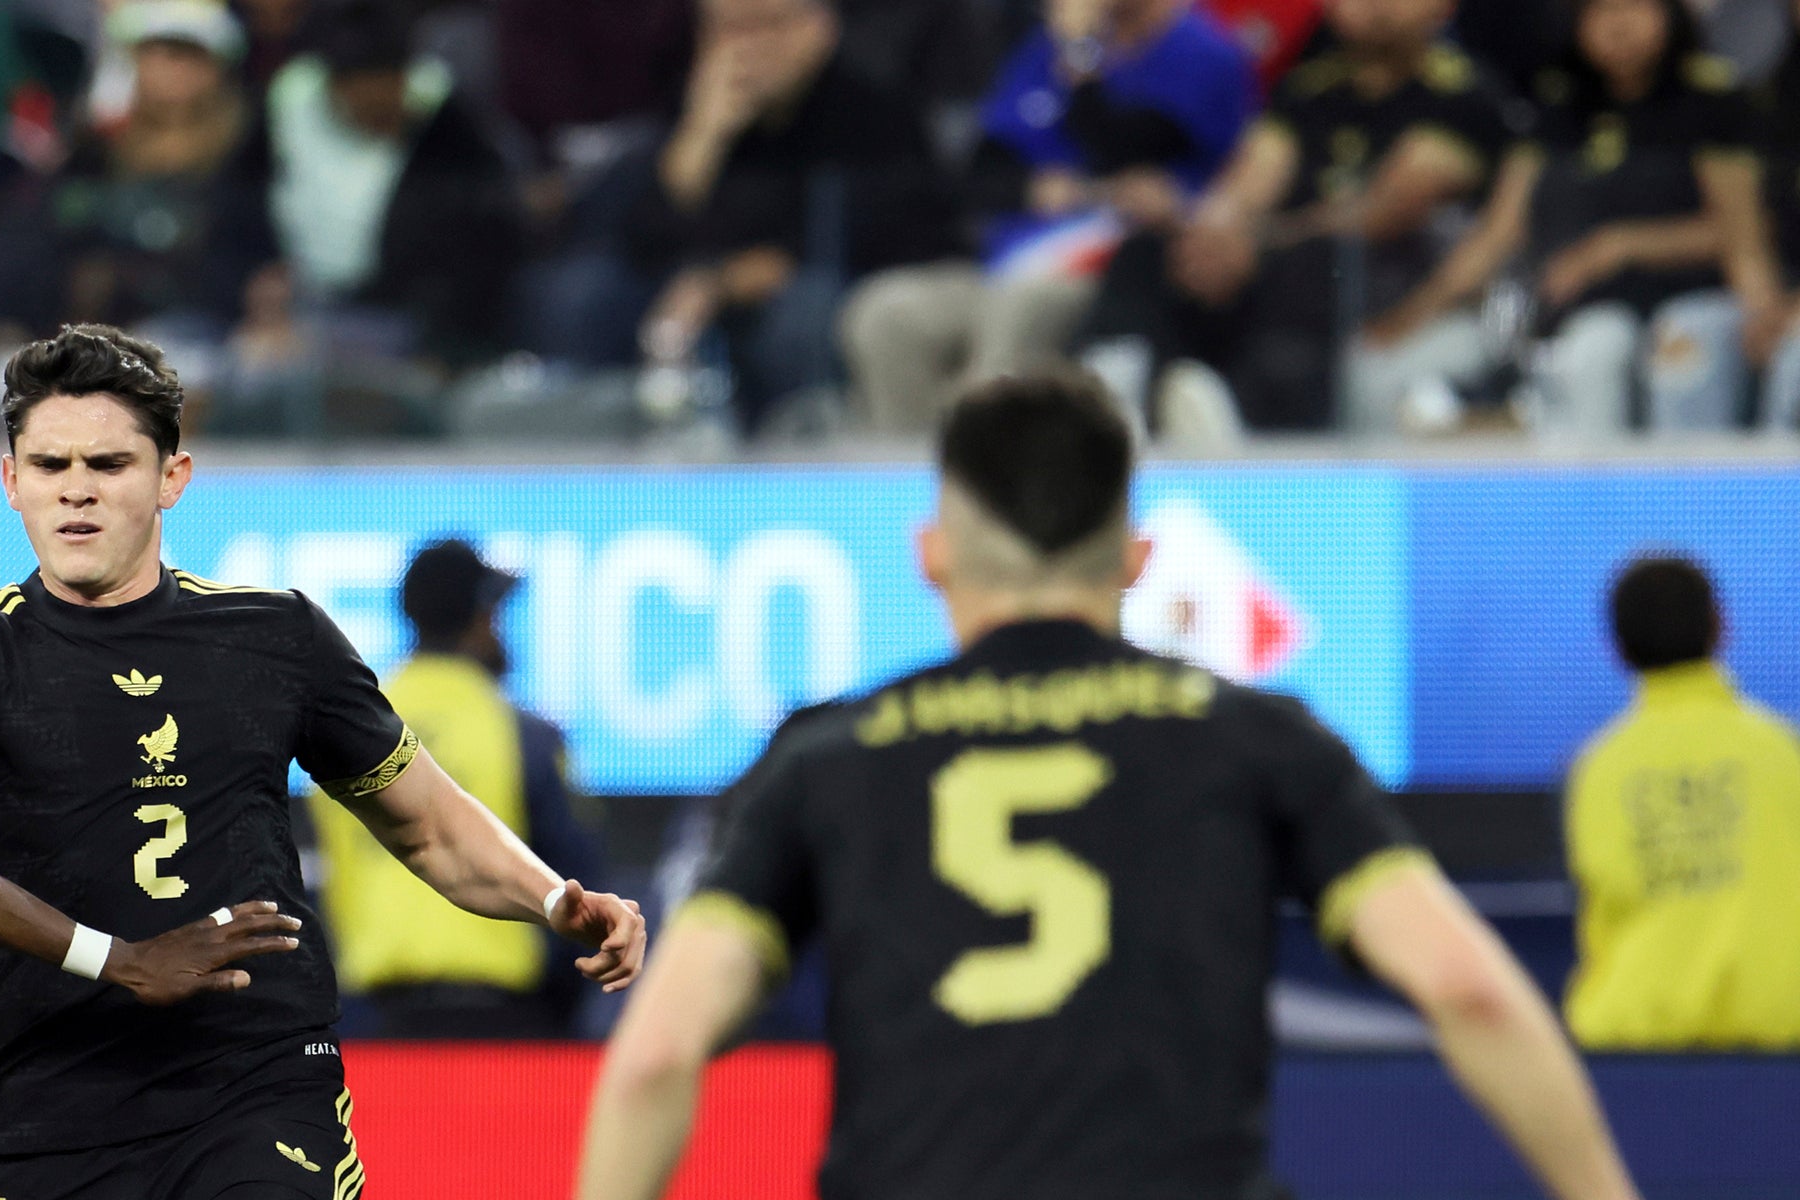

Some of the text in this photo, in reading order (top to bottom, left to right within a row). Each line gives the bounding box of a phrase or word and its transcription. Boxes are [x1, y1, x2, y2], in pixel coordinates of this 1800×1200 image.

[131, 774, 188, 788] MÉXICO
[133, 803, 190, 899] 2
[930, 742, 1115, 1026] 5
